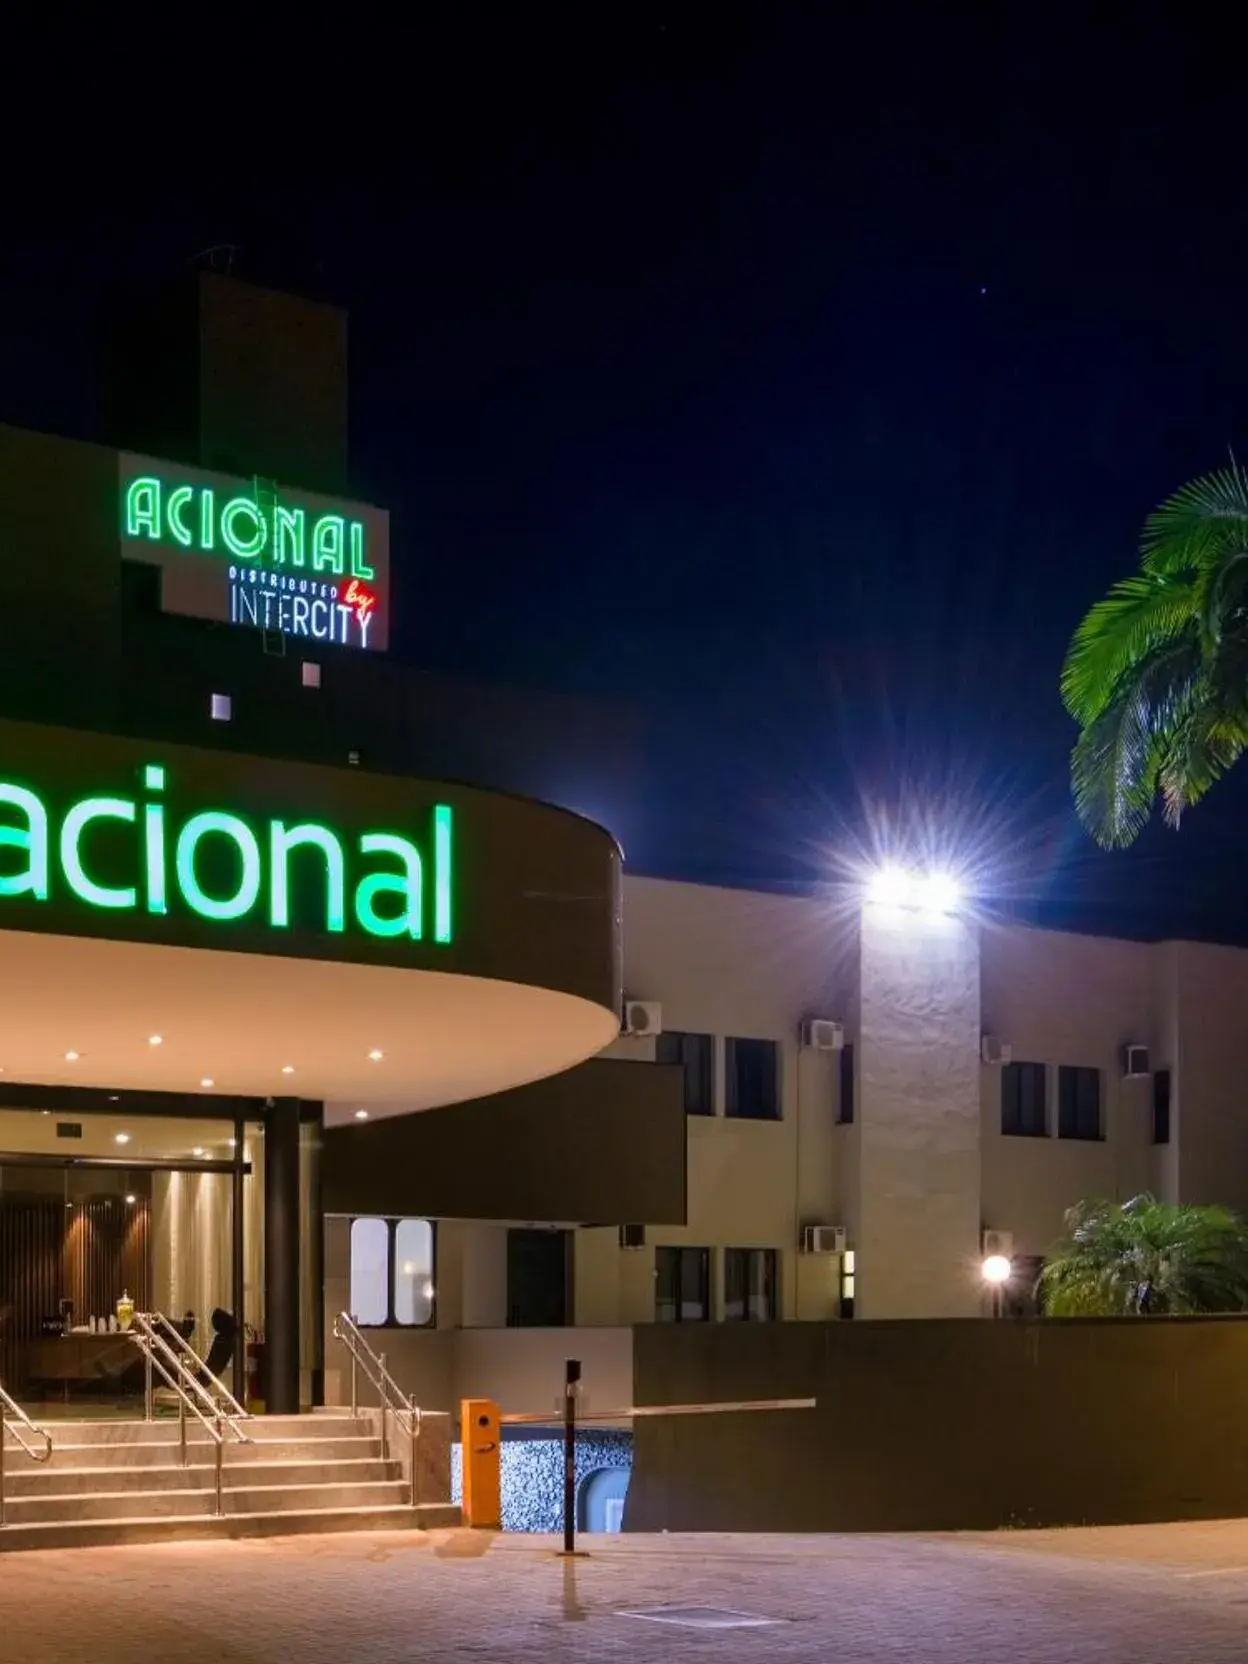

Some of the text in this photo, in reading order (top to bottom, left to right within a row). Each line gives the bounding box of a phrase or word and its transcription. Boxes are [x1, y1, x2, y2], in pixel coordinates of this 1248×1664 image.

[126, 477, 375, 580] ACIONAL
[229, 565, 374, 610] DISTRIBUTED by
[231, 584, 372, 648] INTERCITY
